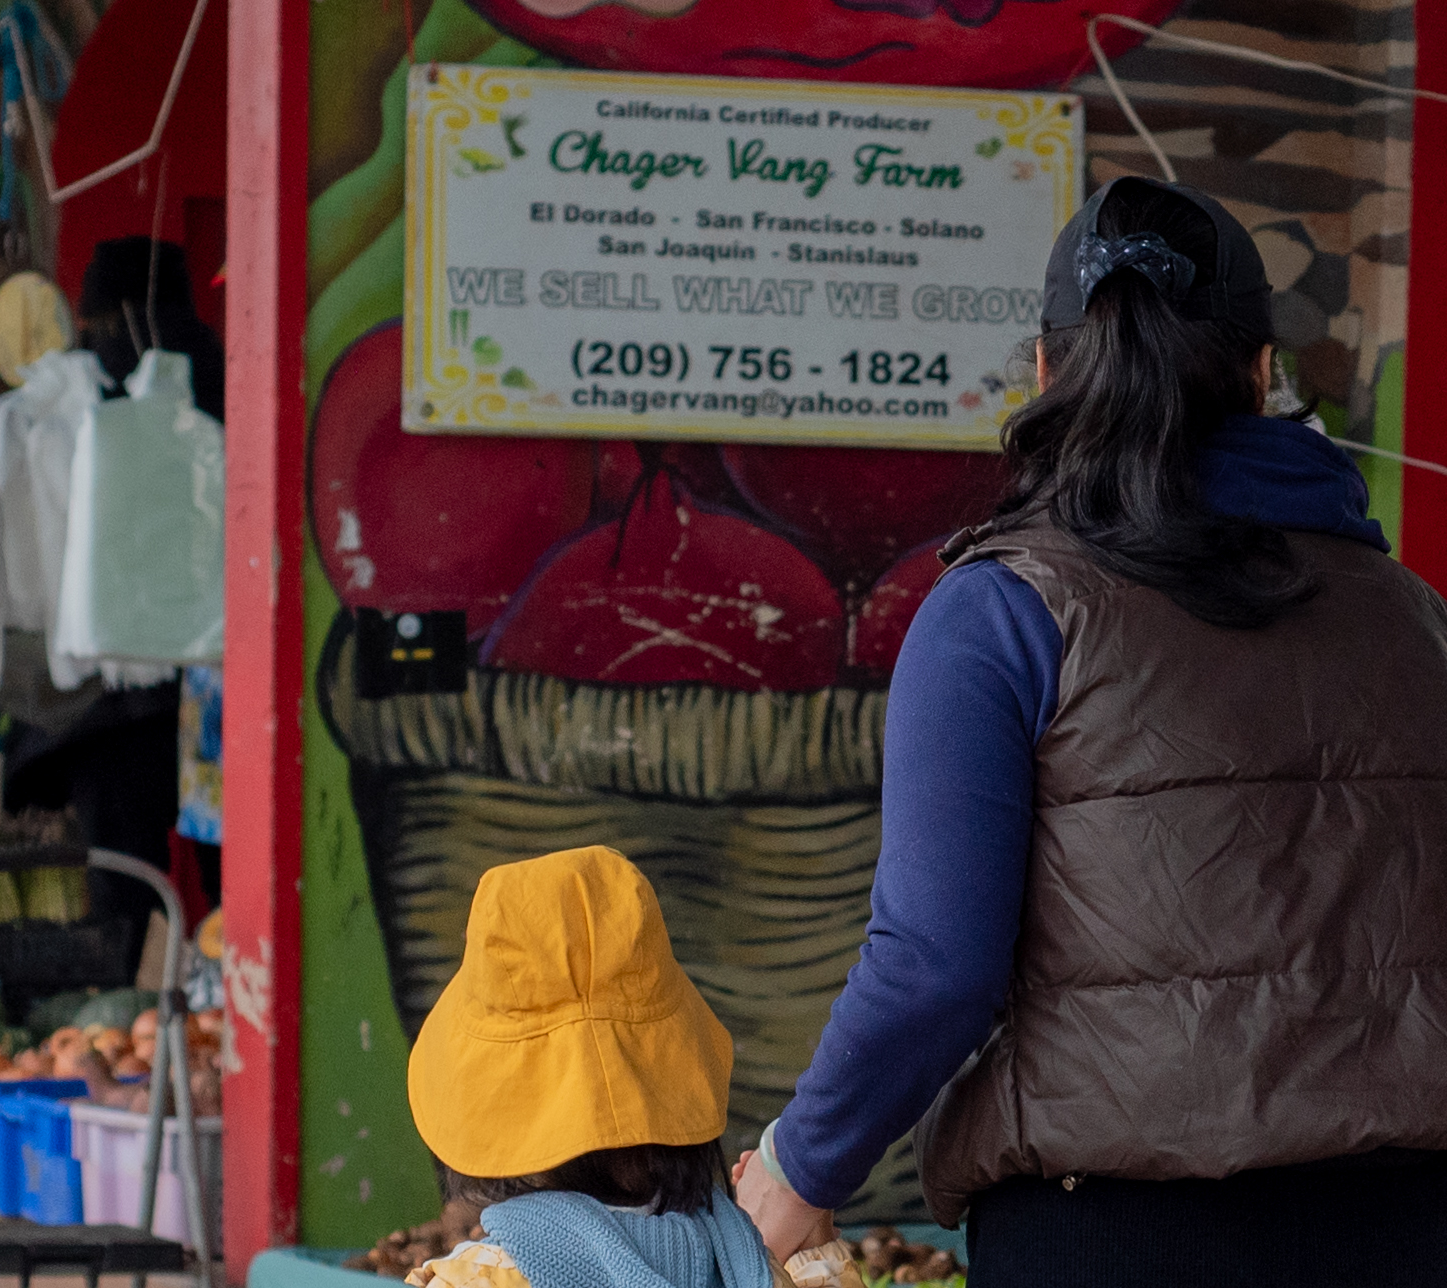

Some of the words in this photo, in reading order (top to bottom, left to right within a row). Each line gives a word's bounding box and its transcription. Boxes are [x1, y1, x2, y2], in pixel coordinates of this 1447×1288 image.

[596, 99, 711, 122] California
[719, 105, 820, 127] Certified
[827, 111, 932, 131] Producer
[548, 130, 709, 191] Chager
[727, 137, 832, 198] Vang
[854, 143, 965, 189] Farm
[530, 202, 554, 222] El
[564, 205, 656, 226] Dorado
[696, 209, 743, 229] San
[753, 212, 876, 235] Francisco
[900, 217, 984, 239] Solano
[598, 235, 646, 255] San
[655, 237, 755, 262] Joaquin
[788, 242, 919, 267] Stanislaus
[447, 267, 526, 306] WE
[539, 269, 660, 311] SELL
[671, 274, 813, 316] WHAT
[825, 280, 899, 320] WE
[911, 283, 1043, 325] GROW
[571, 339, 690, 382] (209)
[708, 344, 792, 382] 756
[840, 350, 950, 386] 1824
[572, 383, 949, 418] chagervang@yahoo.com
